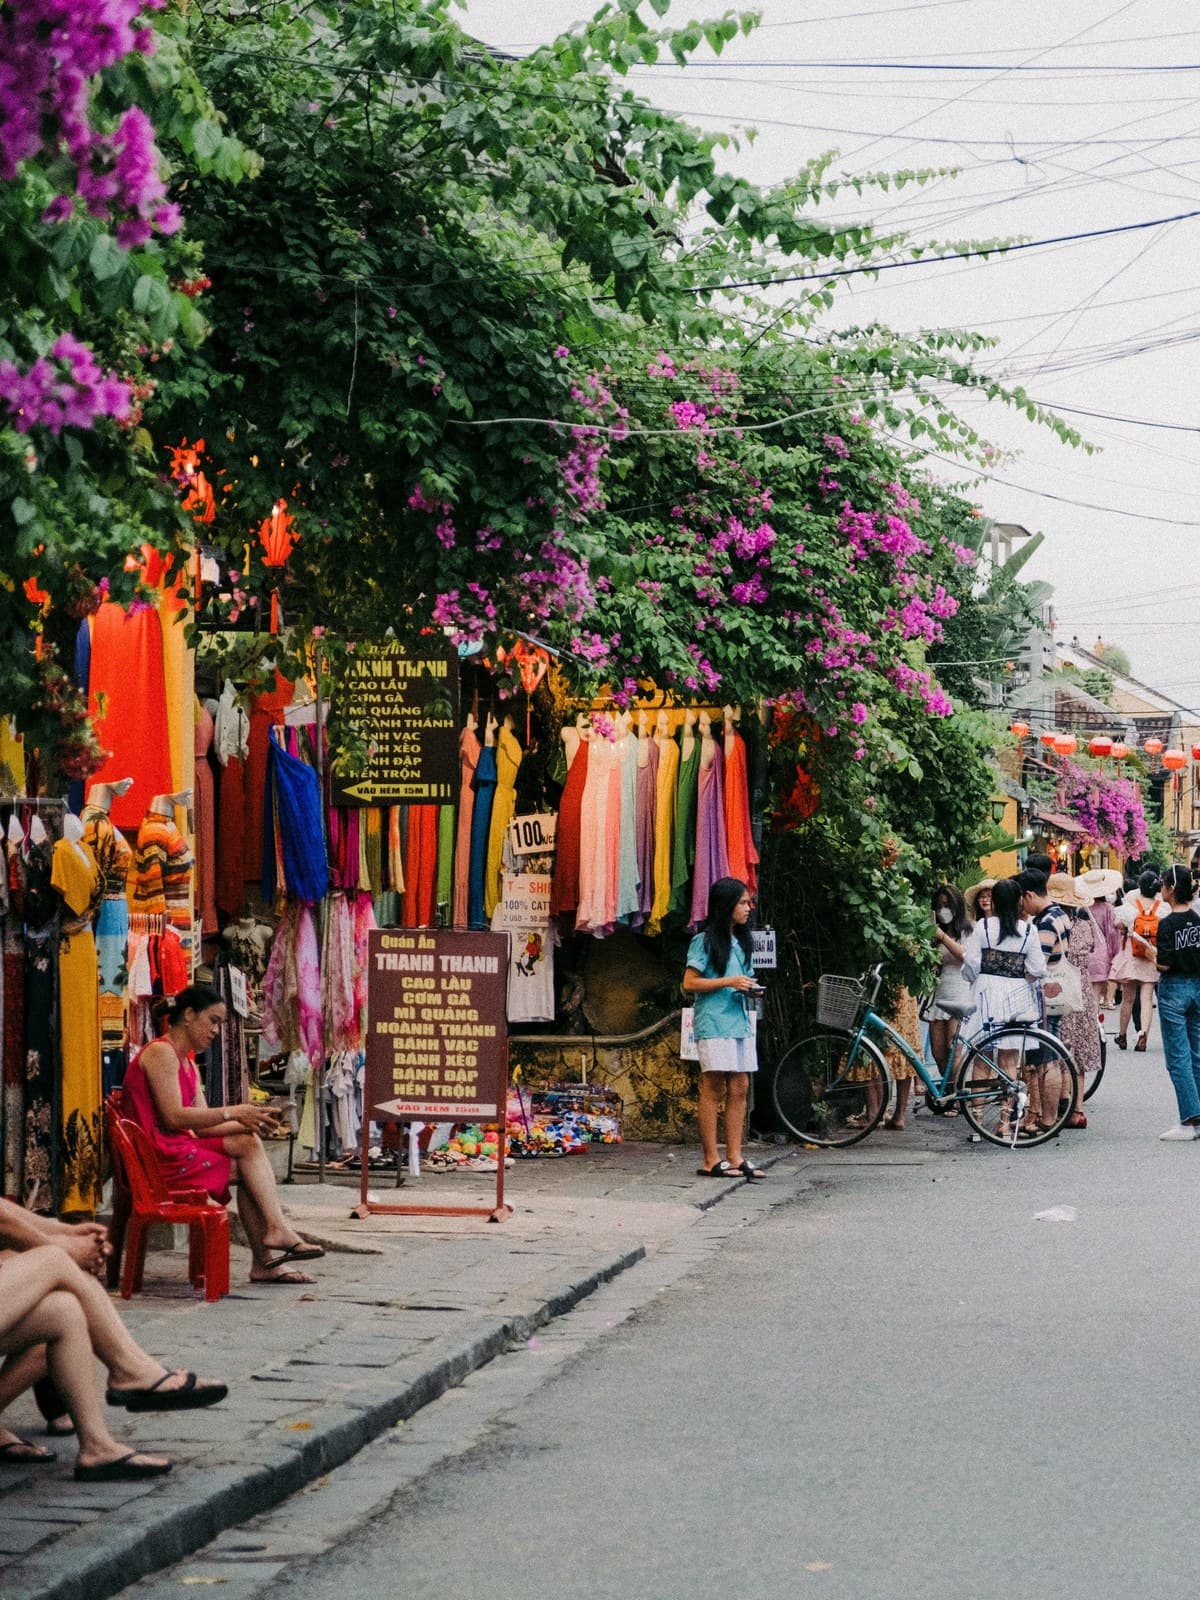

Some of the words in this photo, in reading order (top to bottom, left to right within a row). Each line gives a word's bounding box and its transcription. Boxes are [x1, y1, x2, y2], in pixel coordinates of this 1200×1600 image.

[348, 681, 378, 690] CAO
[384, 692, 404, 703] GÀ
[381, 935, 415, 949] Quán
[375, 953, 434, 972] THANH
[439, 955, 499, 974] THANH
[401, 977, 435, 990] CAO
[402, 992, 442, 1005] CƠM
[447, 992, 471, 1006] GÀ
[376, 1021, 434, 1035] HOÀNH
[393, 1036, 440, 1051] BÁNH
[394, 1052, 441, 1066] BÁNH
[392, 1067, 439, 1081] BÁNH
